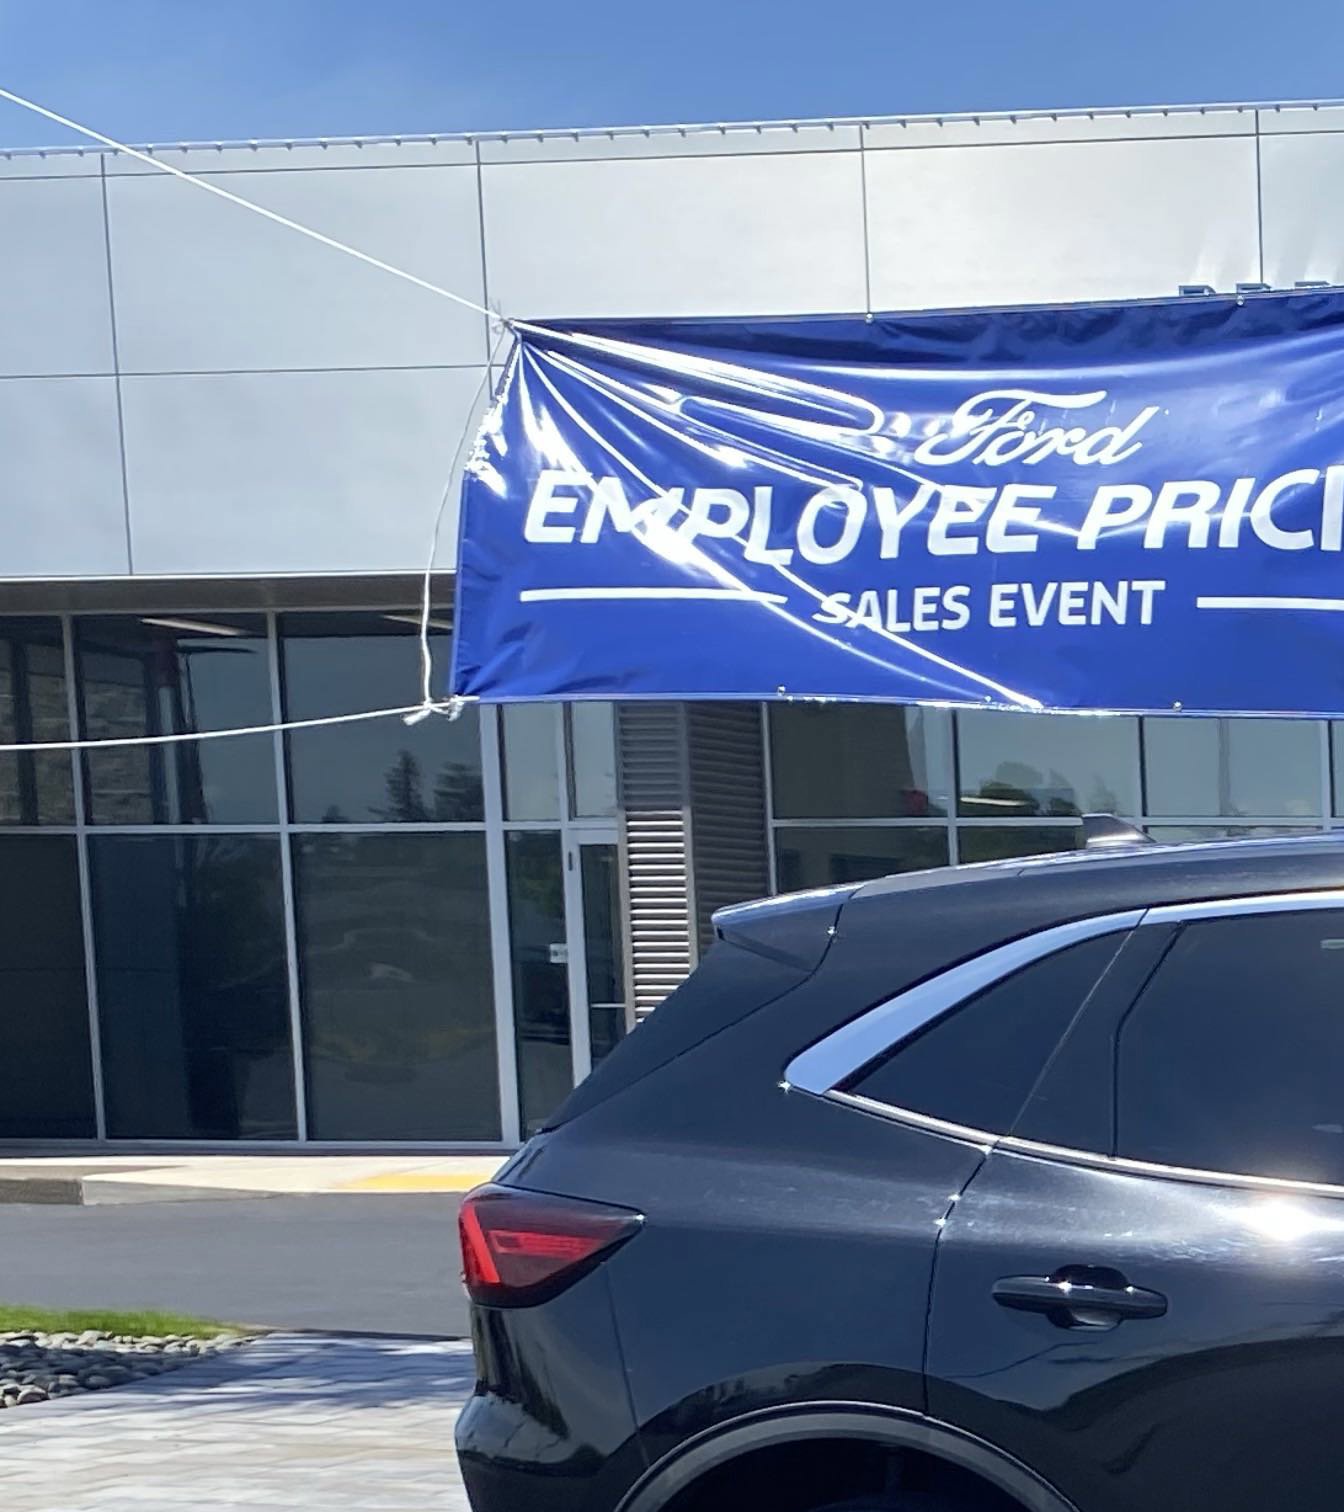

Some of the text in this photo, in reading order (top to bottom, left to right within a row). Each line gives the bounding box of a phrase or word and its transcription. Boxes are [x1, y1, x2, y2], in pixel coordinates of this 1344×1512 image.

[914, 388, 1169, 468] Ford
[522, 466, 1061, 567] EMPLOYEE
[813, 579, 1167, 633] SALES EVENT
